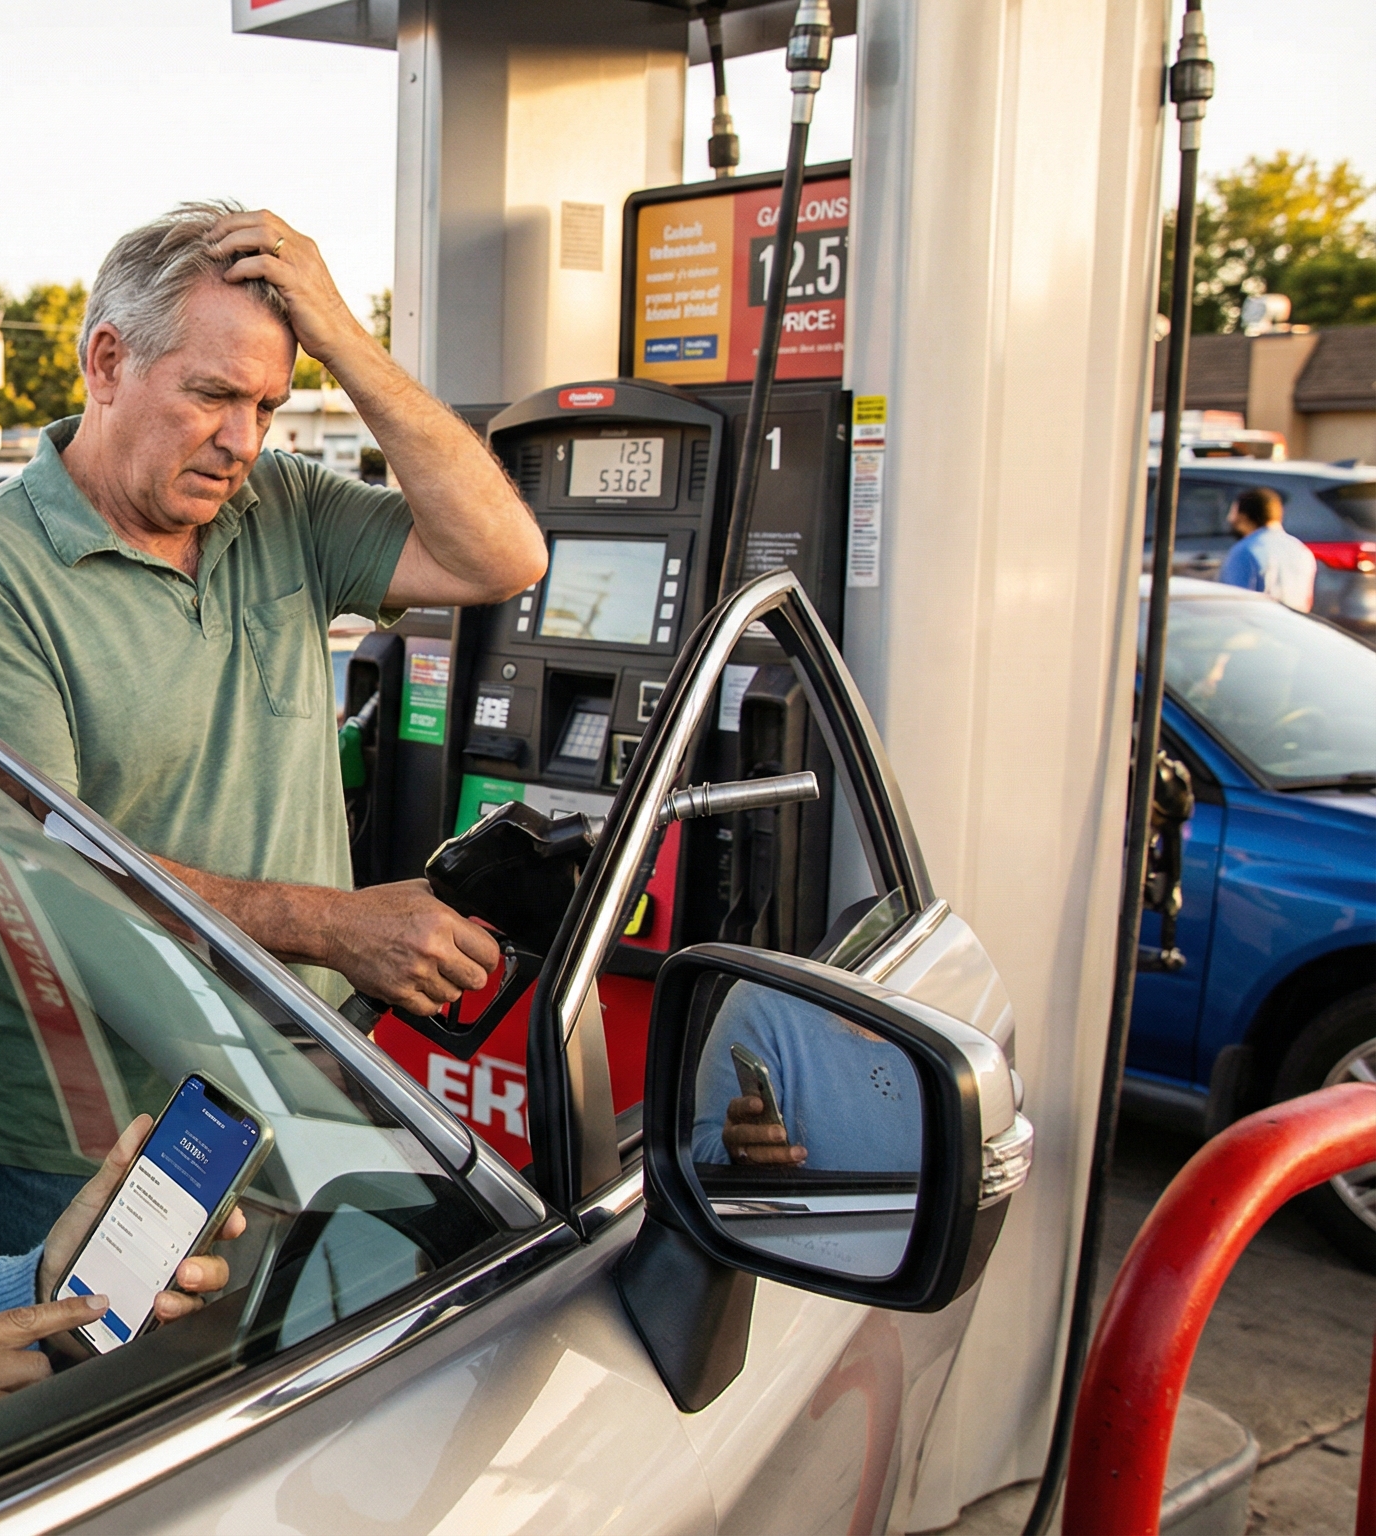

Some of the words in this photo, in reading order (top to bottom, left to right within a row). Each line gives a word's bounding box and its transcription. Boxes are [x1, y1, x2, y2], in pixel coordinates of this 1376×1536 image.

[756, 196, 848, 228] GLONS
[782, 308, 837, 333] RICE:
[766, 426, 781, 470] 1
